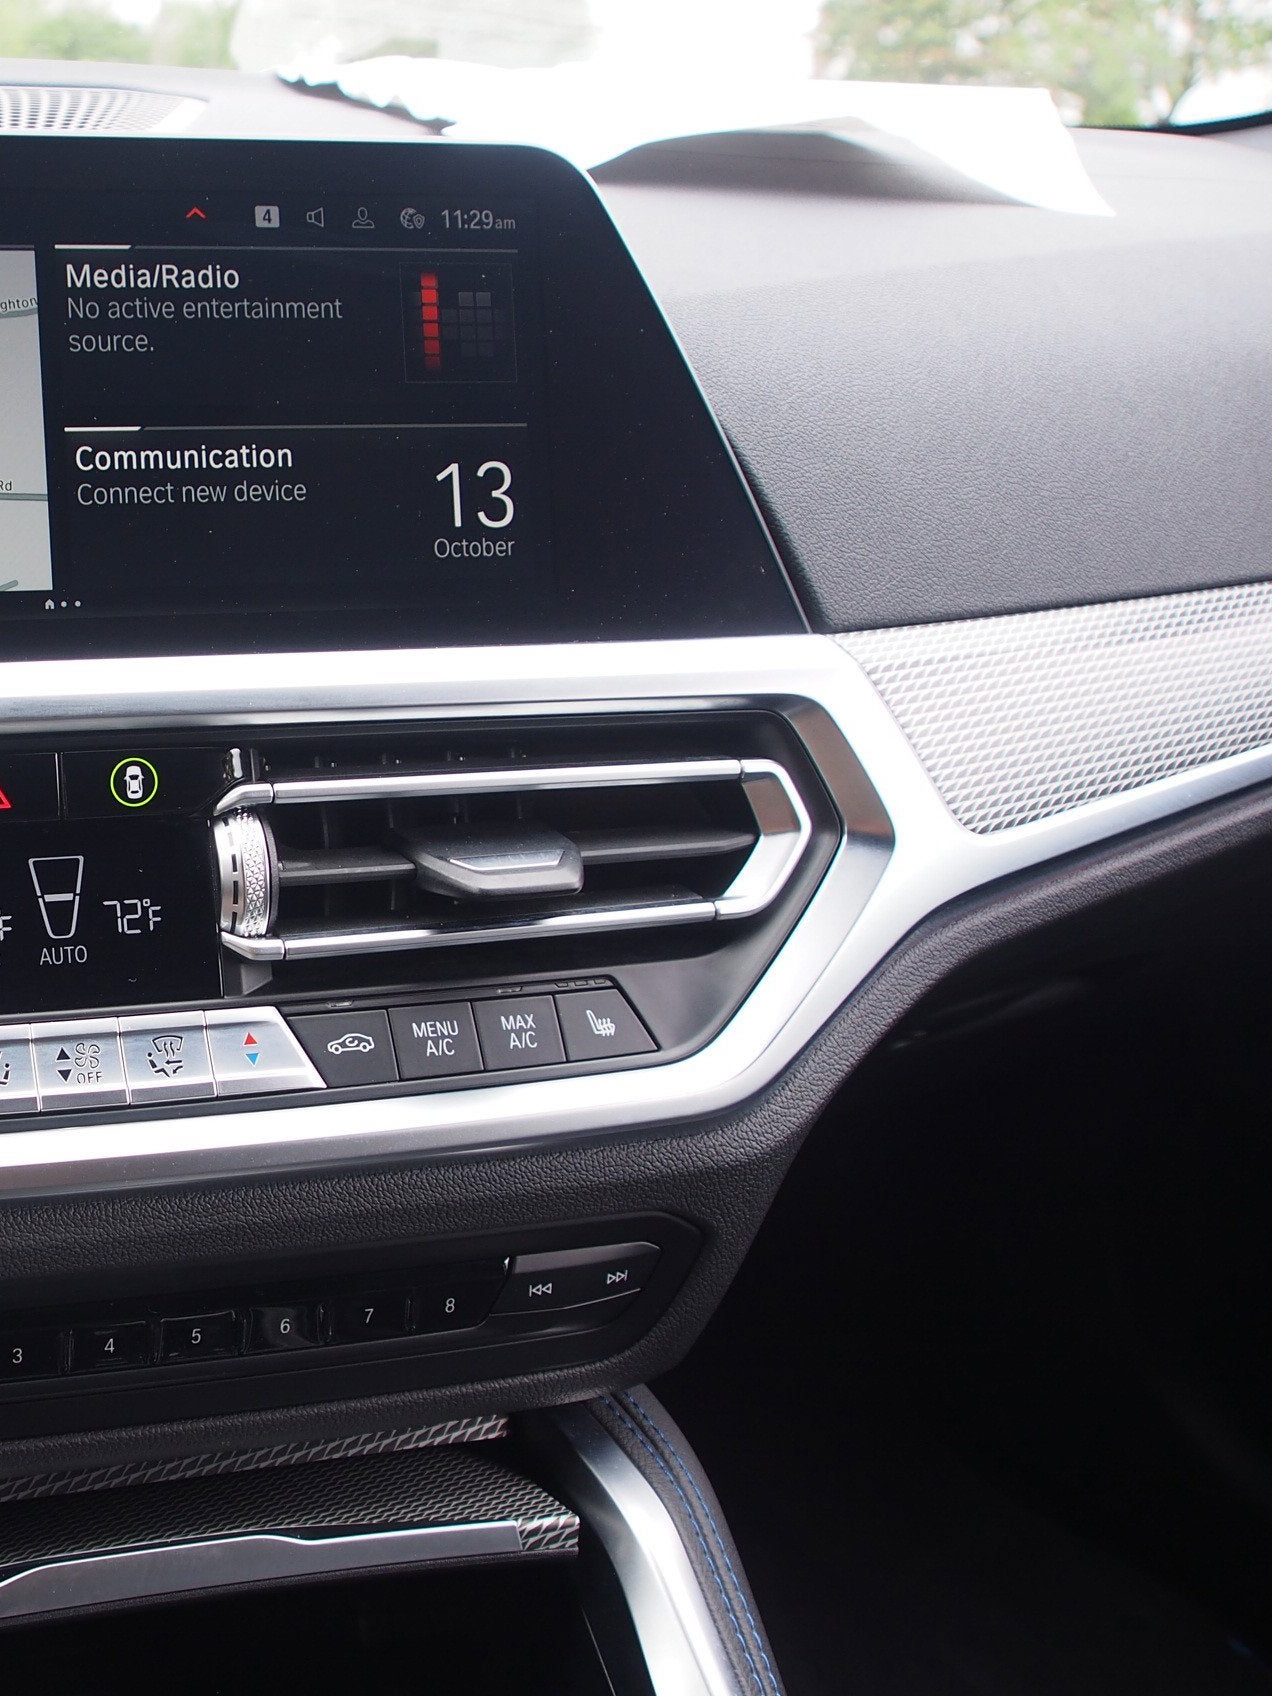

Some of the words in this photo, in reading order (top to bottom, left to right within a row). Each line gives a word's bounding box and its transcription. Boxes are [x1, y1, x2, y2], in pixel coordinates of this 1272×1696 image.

[260, 208, 273, 226] 4
[65, 264, 241, 290] Media/Radio
[67, 298, 100, 319] No
[107, 298, 176, 319] active
[182, 298, 344, 319] entertainment
[68, 333, 156, 353] source.
[74, 443, 294, 473] Communication
[76, 481, 174, 506] Connect
[181, 481, 227, 503] new
[233, 479, 307, 501] device
[435, 460, 516, 529] 13
[433, 538, 515, 558] October
[39, 945, 88, 966] AUTO
[412, 1020, 459, 1037] MENU
[500, 1013, 536, 1031] MAX
[426, 1038, 455, 1057] A/C
[509, 1030, 538, 1050] A/C
[76, 1071, 102, 1085] OFF
[444, 1297, 456, 1314] 8
[364, 1308, 374, 1324] 7
[279, 1317, 291, 1334] 6
[190, 1328, 202, 1344] 5
[103, 1338, 116, 1354] 4
[11, 1347, 24, 1364] 3
